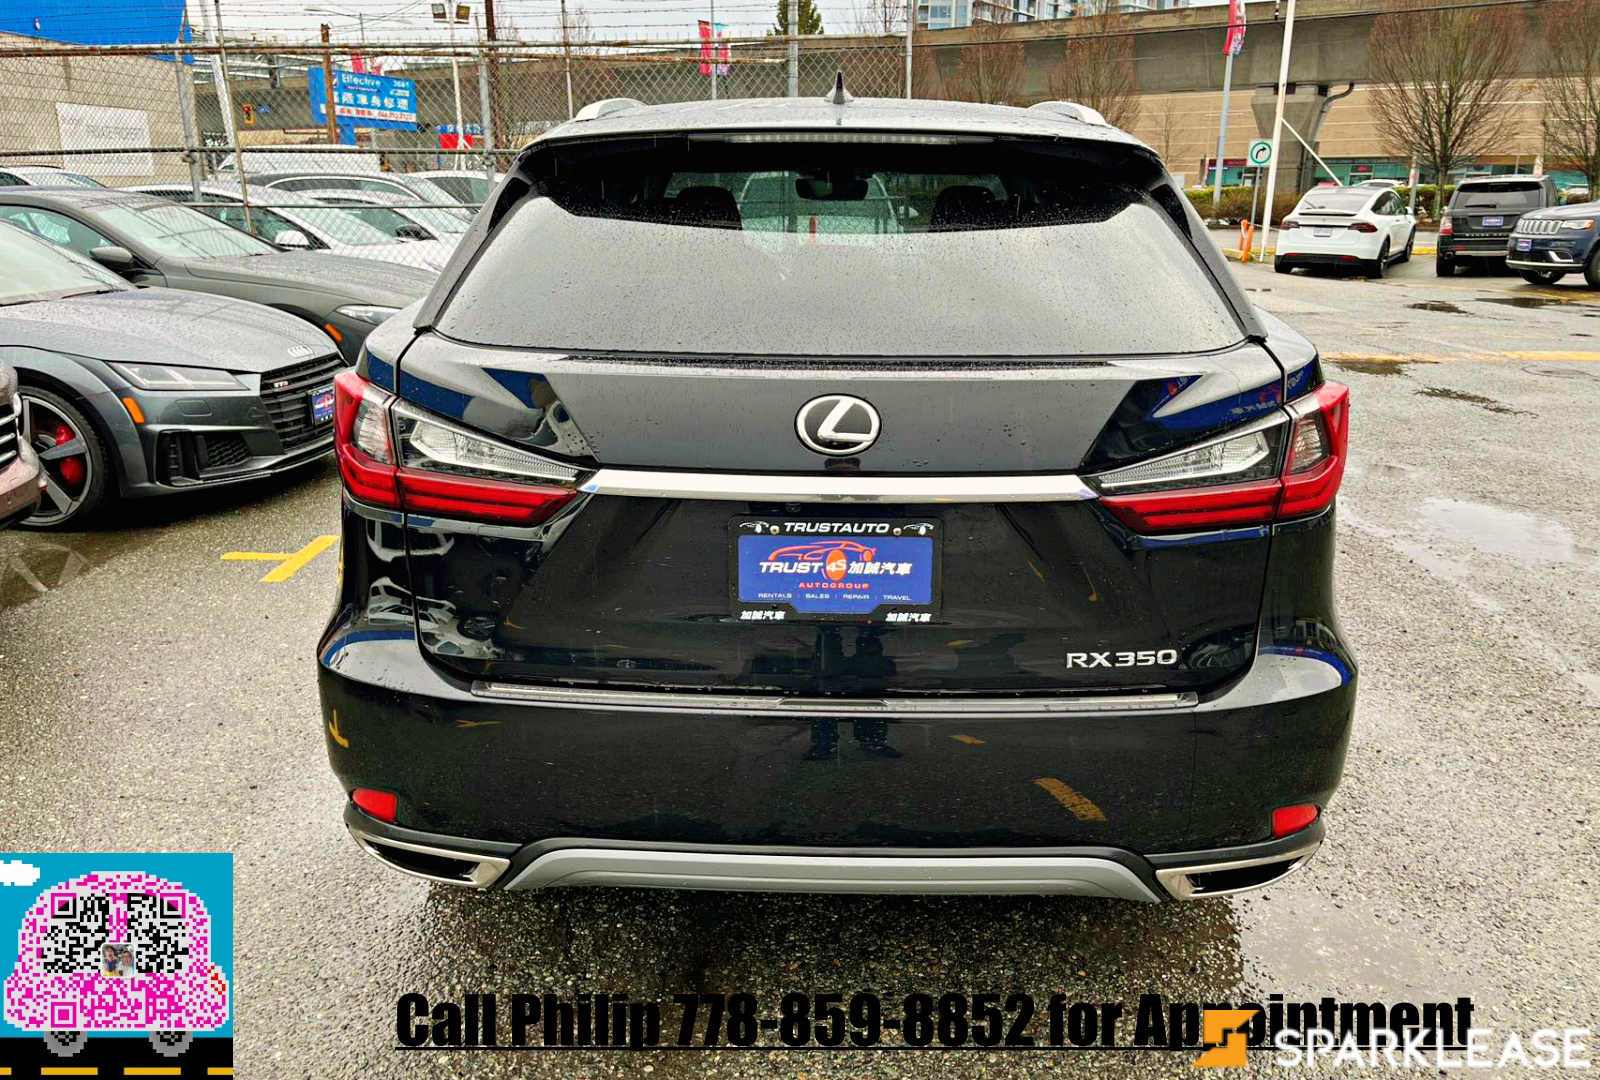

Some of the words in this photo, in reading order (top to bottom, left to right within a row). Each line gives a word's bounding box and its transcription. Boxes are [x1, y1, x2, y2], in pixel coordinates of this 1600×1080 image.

[784, 522, 890, 534] TRUSTAUTO
[759, 561, 824, 574] TRUST
[799, 582, 870, 590] AUTOGROUP
